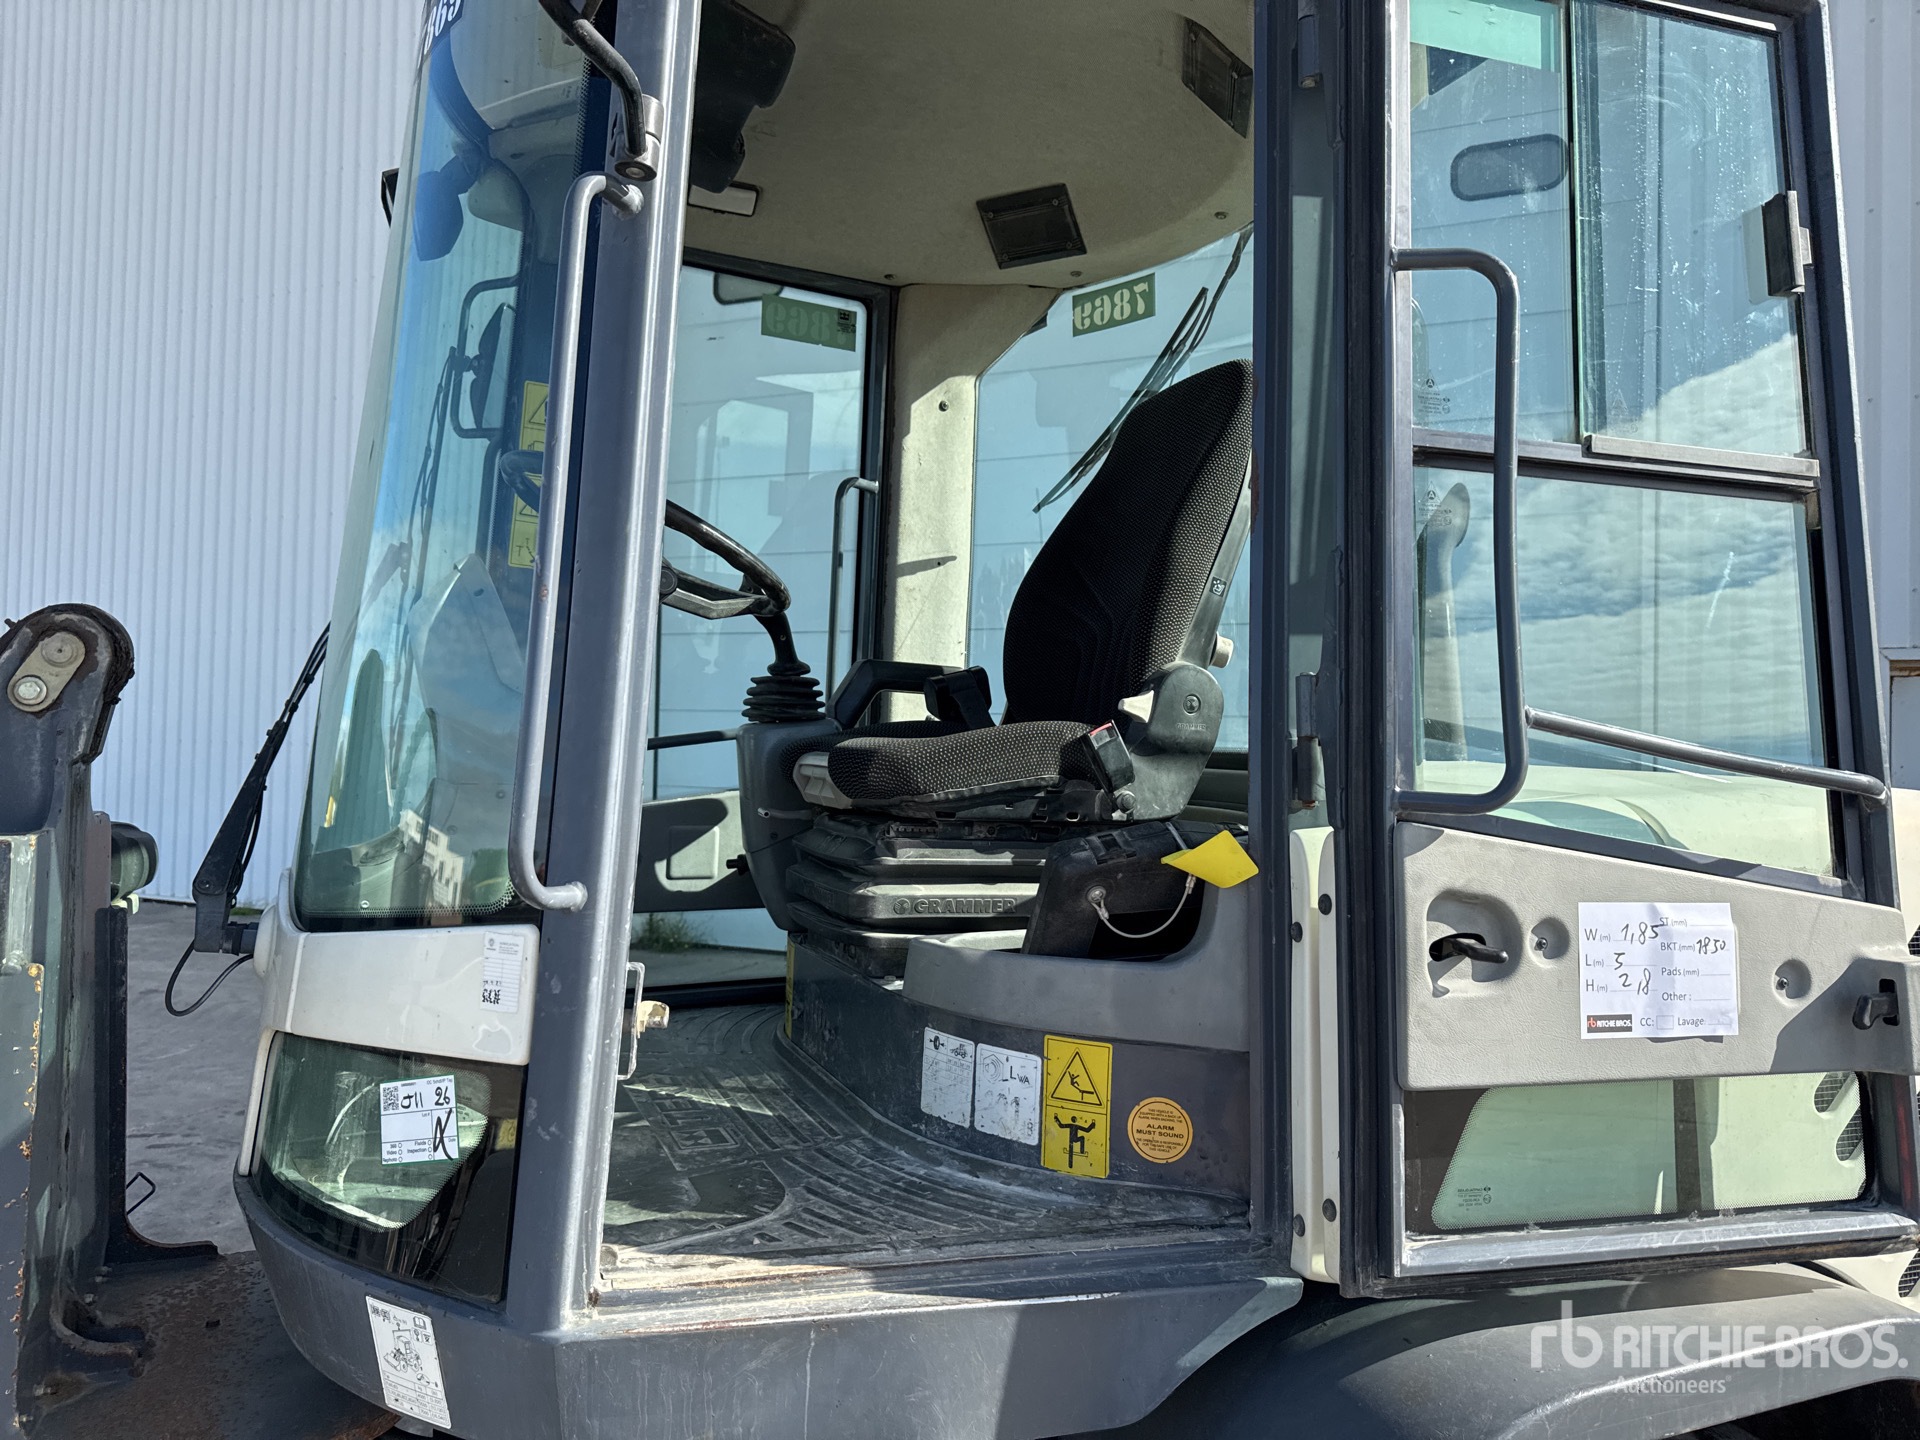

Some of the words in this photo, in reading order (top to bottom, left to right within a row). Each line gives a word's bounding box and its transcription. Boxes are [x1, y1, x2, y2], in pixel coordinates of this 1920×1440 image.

[914, 898, 1016, 914] GRAMMER
[1584, 928, 1598, 941] W
[1660, 942, 1677, 951] BKT
[1696, 936, 1726, 954] 1850
[1585, 954, 1592, 966] L
[1662, 968, 1681, 976] Pads
[1586, 979, 1594, 992] H
[1662, 992, 1686, 1001] Other
[435, 1086, 450, 1106] 26
